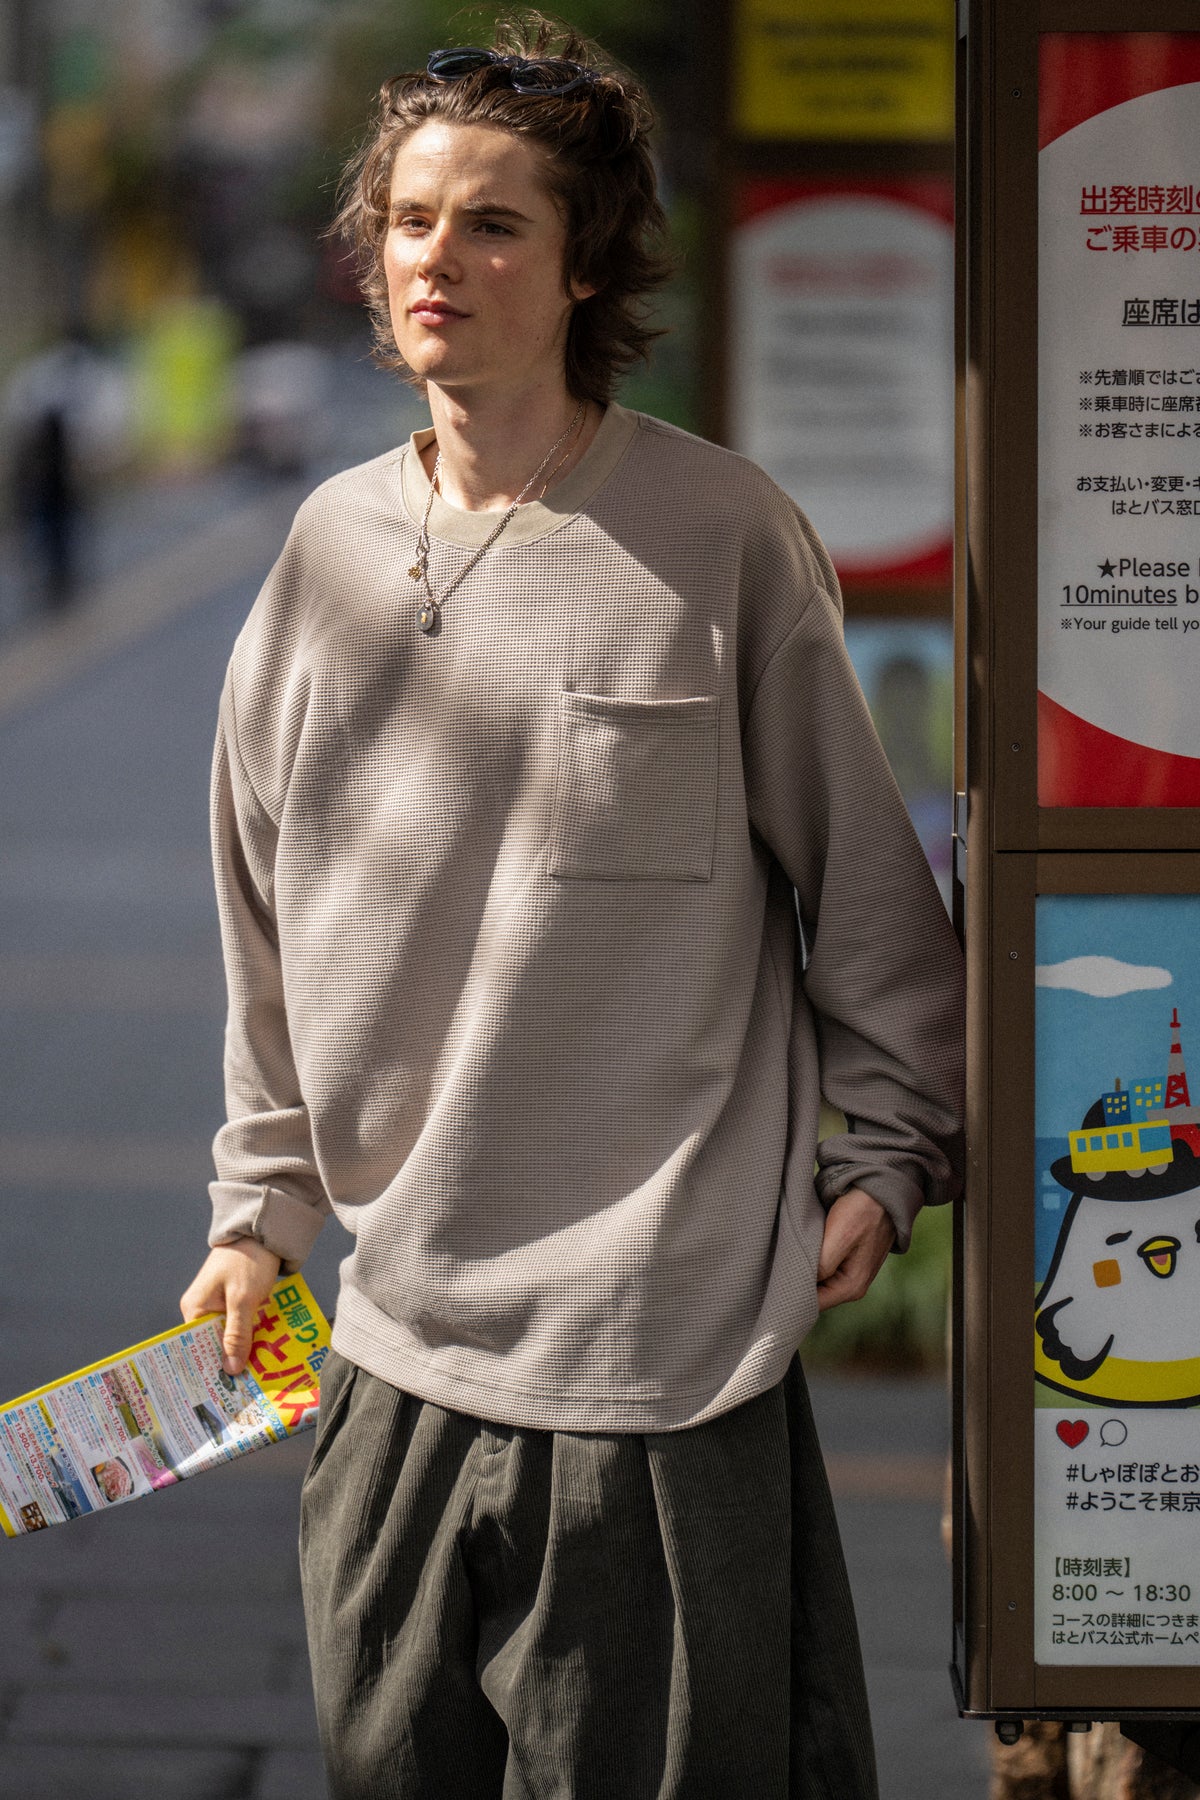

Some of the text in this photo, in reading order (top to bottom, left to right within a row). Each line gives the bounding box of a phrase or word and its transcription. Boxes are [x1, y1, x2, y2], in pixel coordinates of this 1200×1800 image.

[1081, 185, 1200, 213] 出発時刻
[1086, 225, 1200, 253] ご乗車の
[1080, 369, 1200, 387] ※先着順ではご
[1080, 396, 1200, 412] ※乗車時に座席
[1062, 585, 1177, 604] 10minutes
[1111, 617, 1150, 633] guide
[1155, 617, 1178, 630] tell
[1055, 1557, 1131, 1577] 【時刻表】
[1052, 1584, 1097, 1602] 8:00
[1134, 1584, 1191, 1602] 18:30
[1052, 1614, 1199, 1628] コースの詳細につきま
[1052, 1631, 1199, 1645] はとバス公式ホームペ
